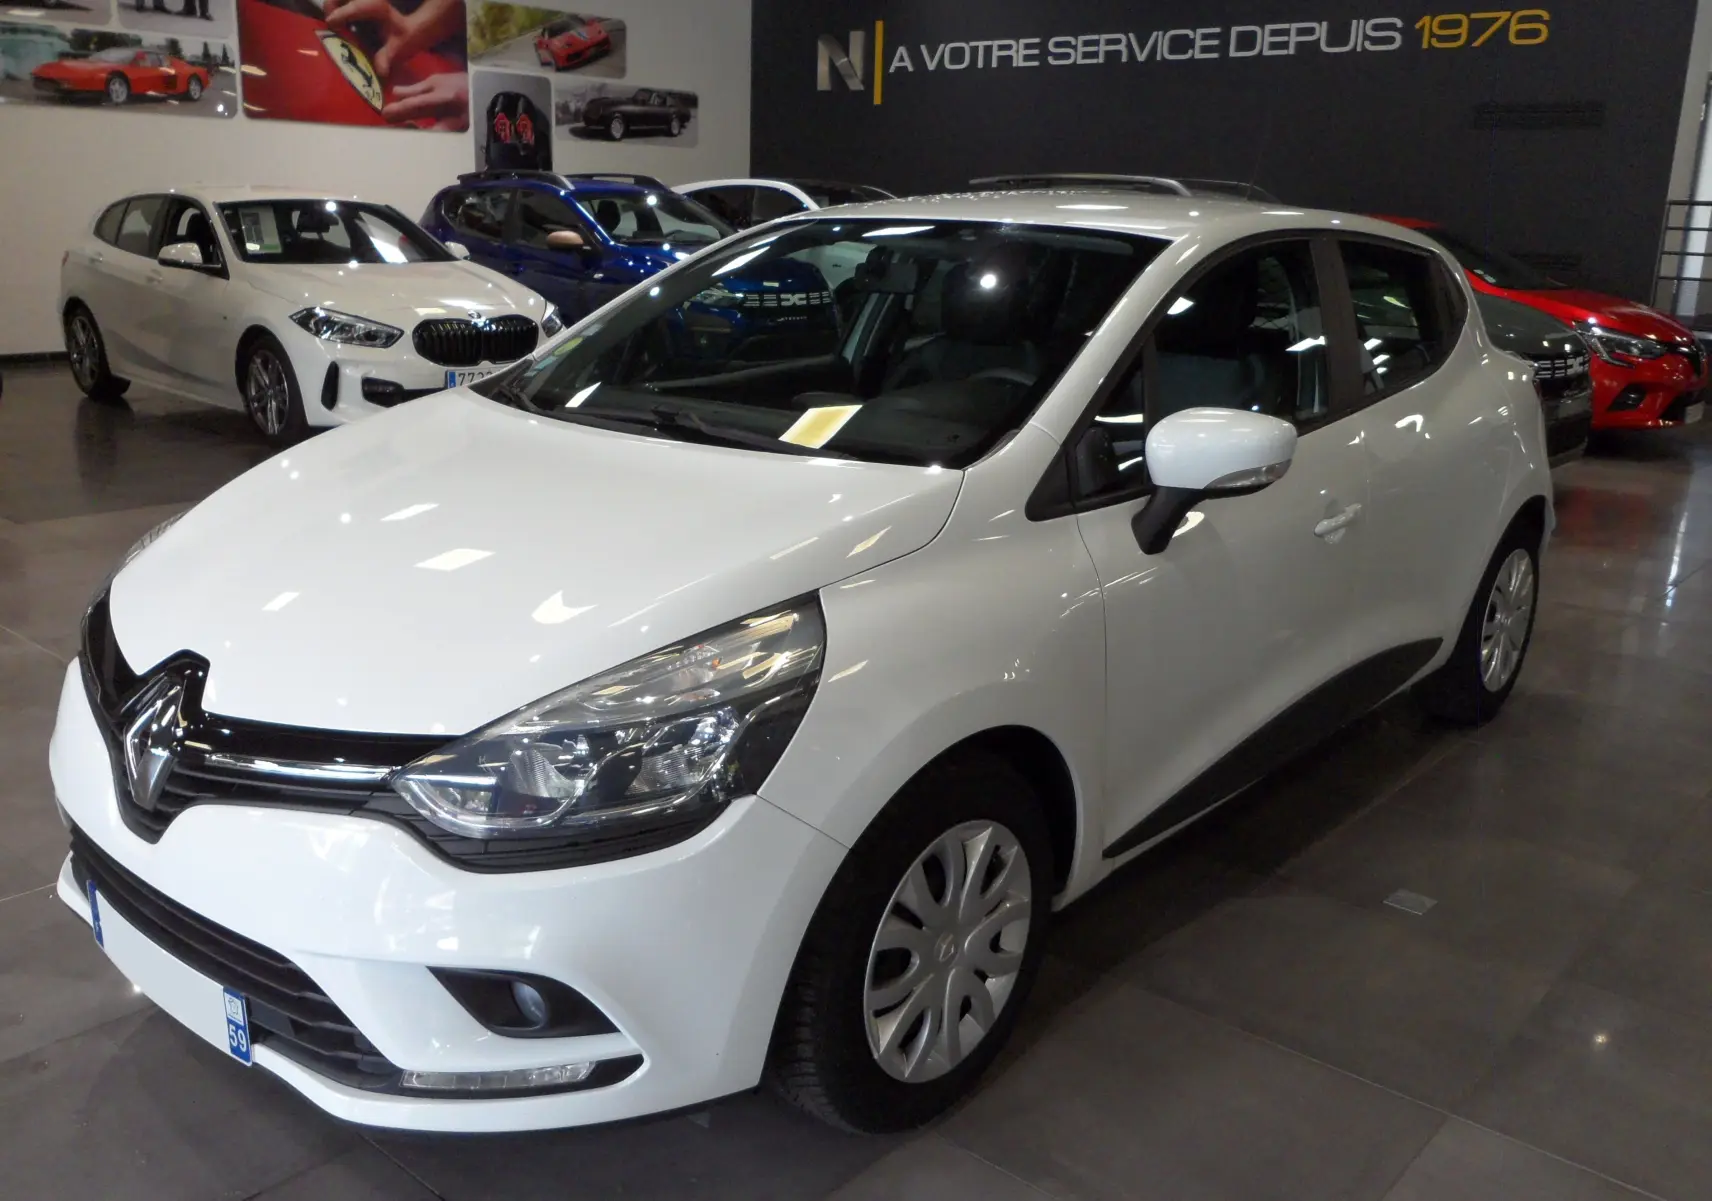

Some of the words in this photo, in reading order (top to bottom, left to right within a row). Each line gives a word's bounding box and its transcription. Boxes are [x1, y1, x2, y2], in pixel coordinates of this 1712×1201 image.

[817, 31, 864, 91] N
[888, 45, 914, 74] A
[919, 38, 1042, 71] VOTRE
[1047, 28, 1222, 66] SERVICE
[1228, 17, 1405, 58] DEPUIS
[1414, 9, 1551, 49] 1976
[228, 1024, 247, 1053] 59
